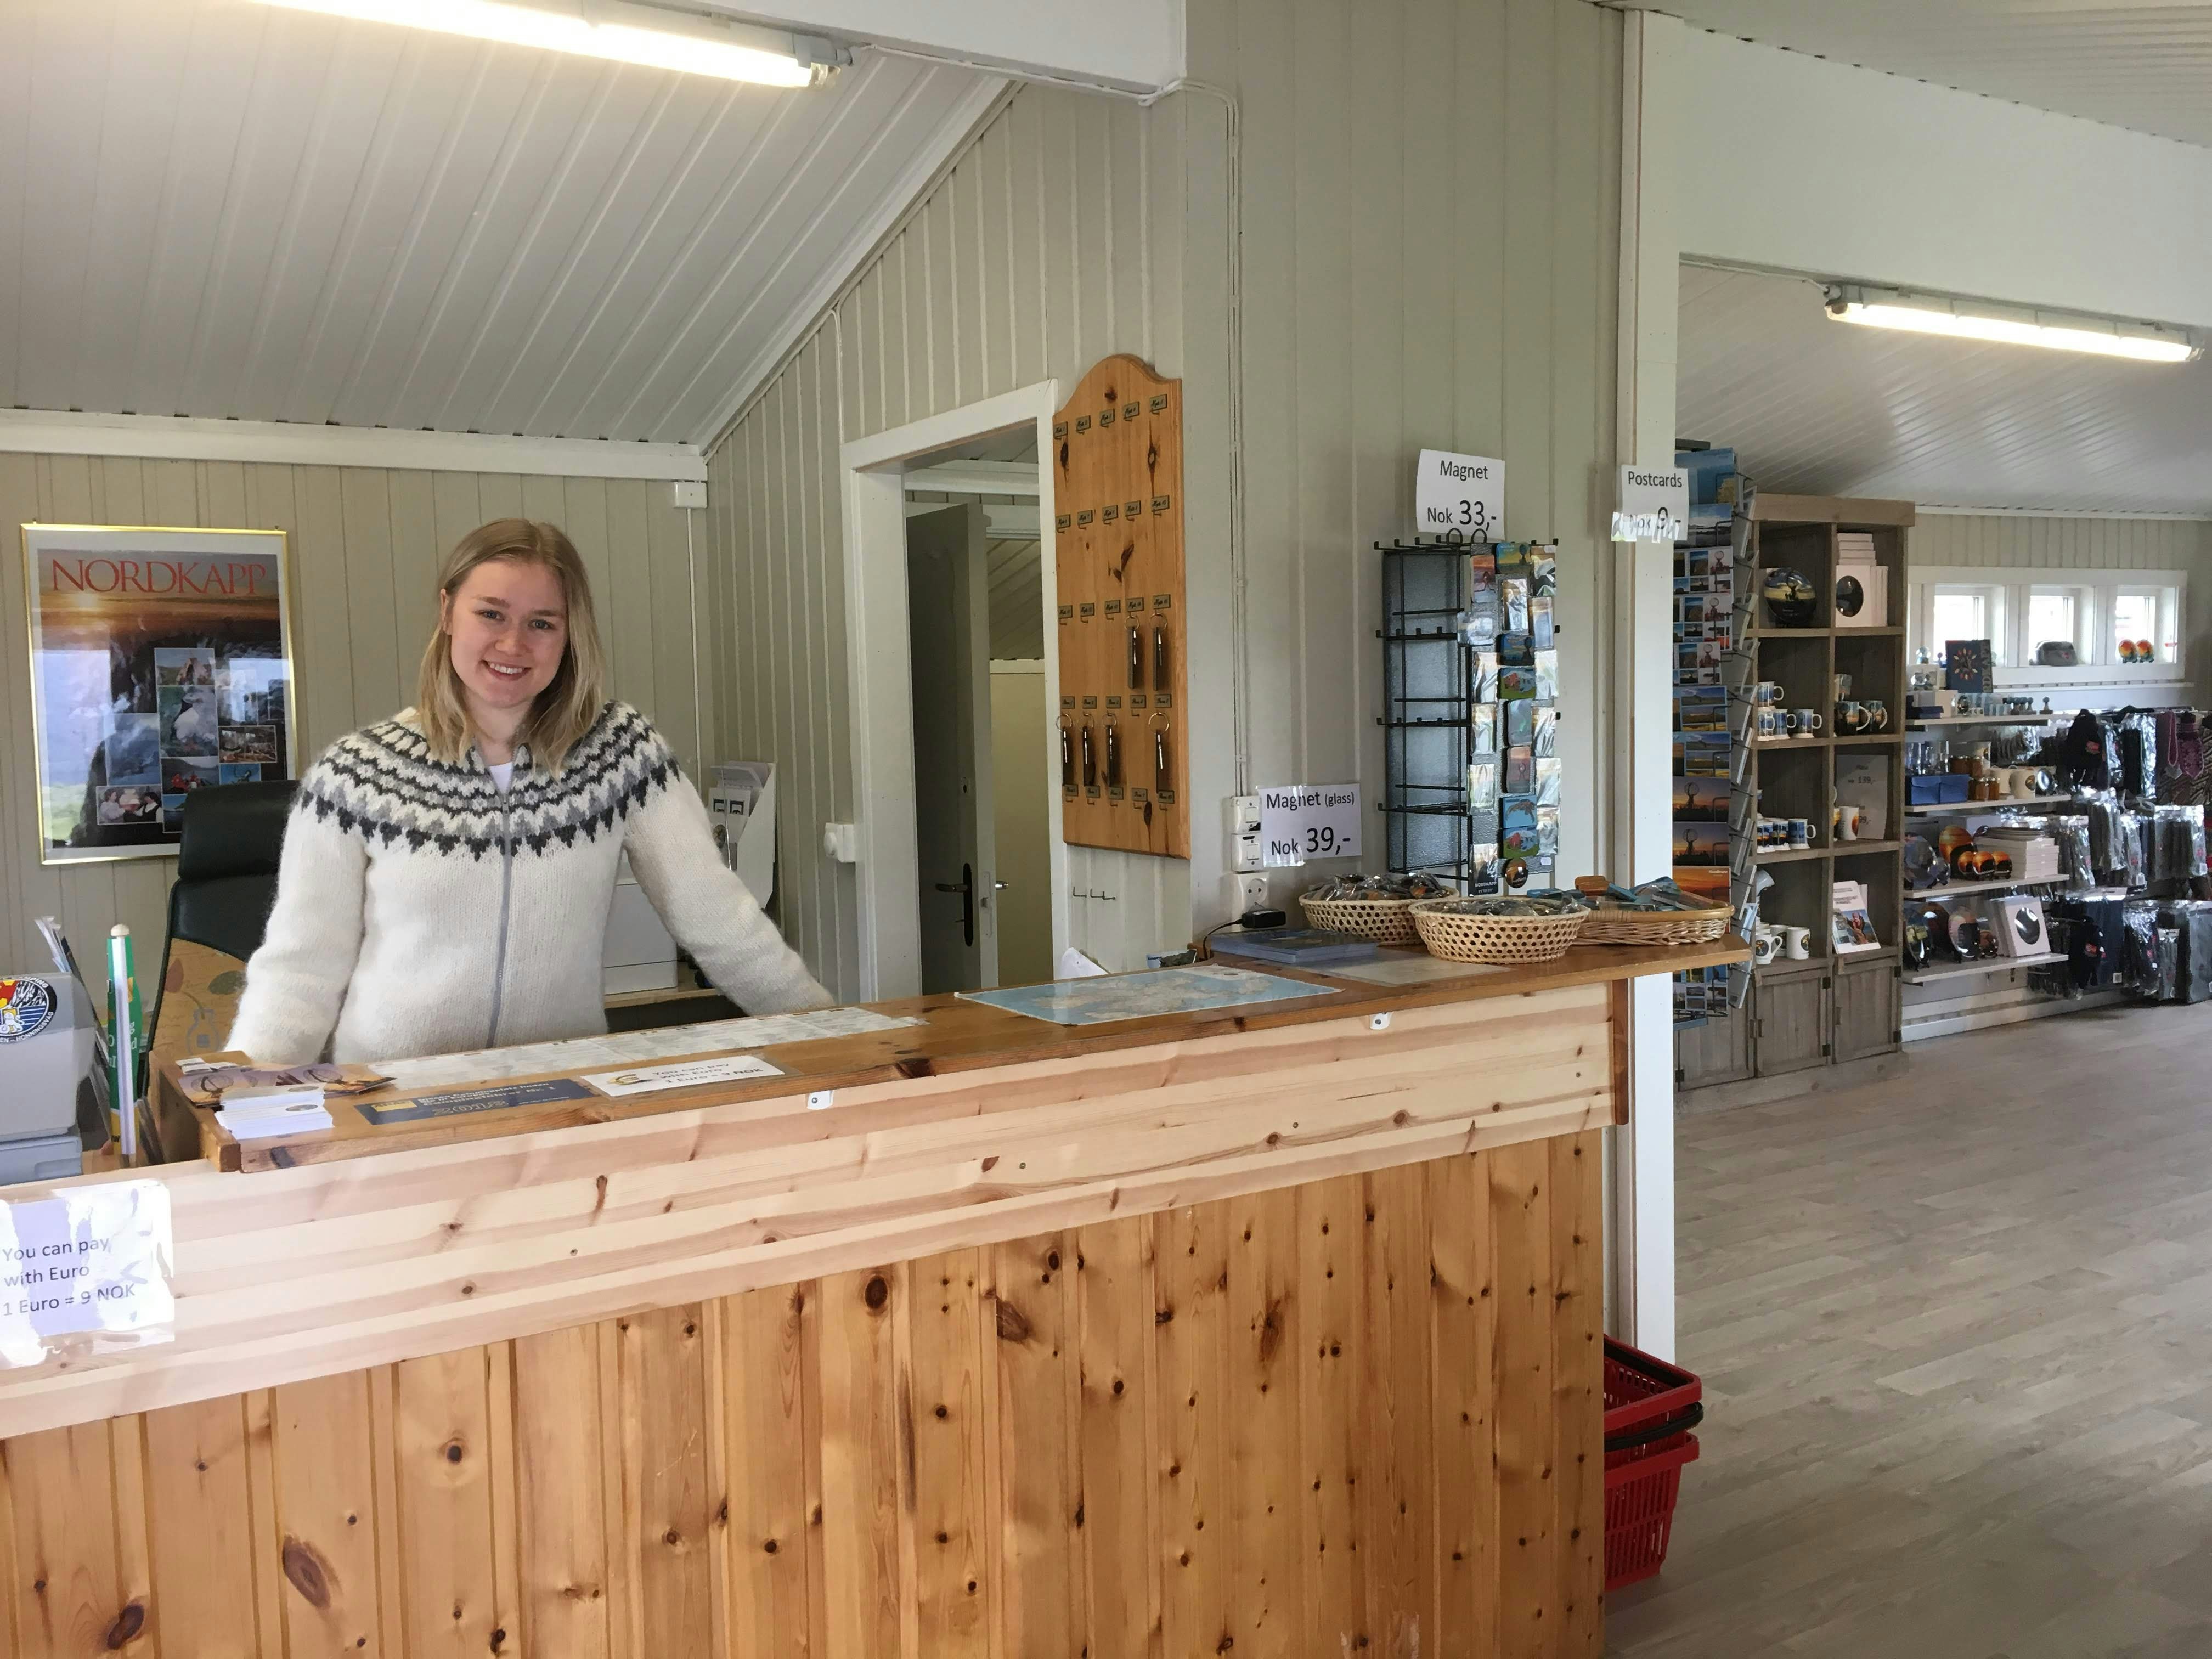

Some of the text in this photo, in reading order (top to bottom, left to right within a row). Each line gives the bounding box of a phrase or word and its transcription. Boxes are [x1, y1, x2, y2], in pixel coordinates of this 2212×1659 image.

[1440, 460, 1488, 481] Magnet
[1628, 471, 1683, 488] Postcards
[1427, 500, 1497, 531] Nok 33,-
[52, 558, 267, 595] NORDKAPP
[1266, 792, 1355, 811] Magnet (glass)
[1271, 826, 1351, 855] Nok 39,-
[2, 1237, 110, 1262] You can pay
[4, 1265, 90, 1287] with Euro
[3, 1302, 13, 1316] 1
[19, 1297, 60, 1313] Euro
[80, 1291, 91, 1305] 9
[97, 1283, 136, 1301] NOK
